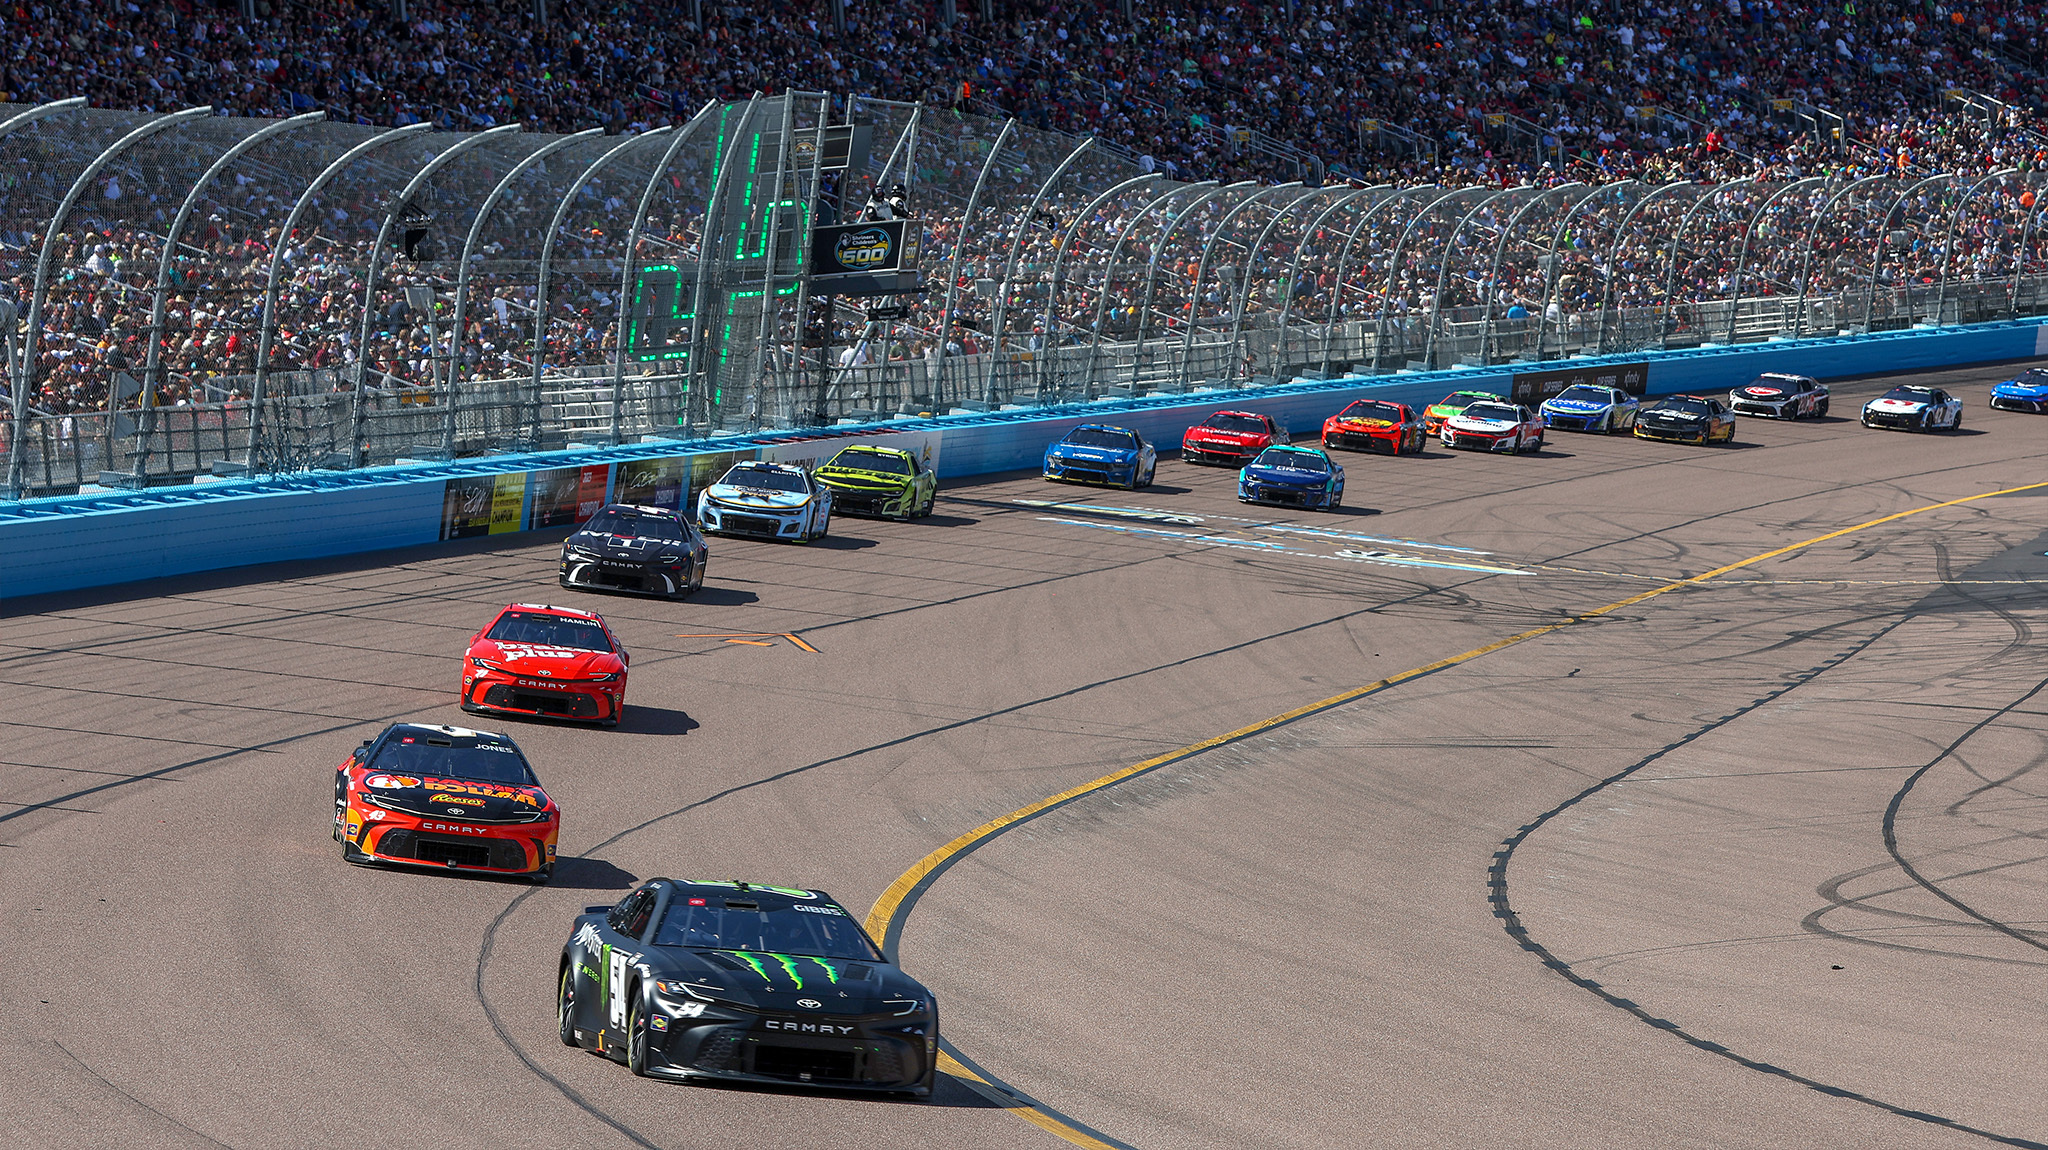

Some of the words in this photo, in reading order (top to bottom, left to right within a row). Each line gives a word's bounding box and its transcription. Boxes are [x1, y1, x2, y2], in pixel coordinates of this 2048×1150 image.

[841, 247, 885, 264] 500
[770, 469, 797, 477] ELLIOTT
[602, 560, 643, 569] CAMRY
[559, 617, 598, 627] HAMLIN
[503, 649, 575, 662] plus
[518, 679, 568, 690] CAMRY
[474, 743, 514, 754] JONES
[423, 782, 538, 808] DOLLAR
[431, 794, 483, 807] Reese's
[368, 809, 387, 821] 43
[422, 821, 488, 835] CAMRY
[793, 904, 842, 917] GIBBS
[675, 1000, 708, 1018] 54
[765, 1020, 855, 1035] CAMRY
